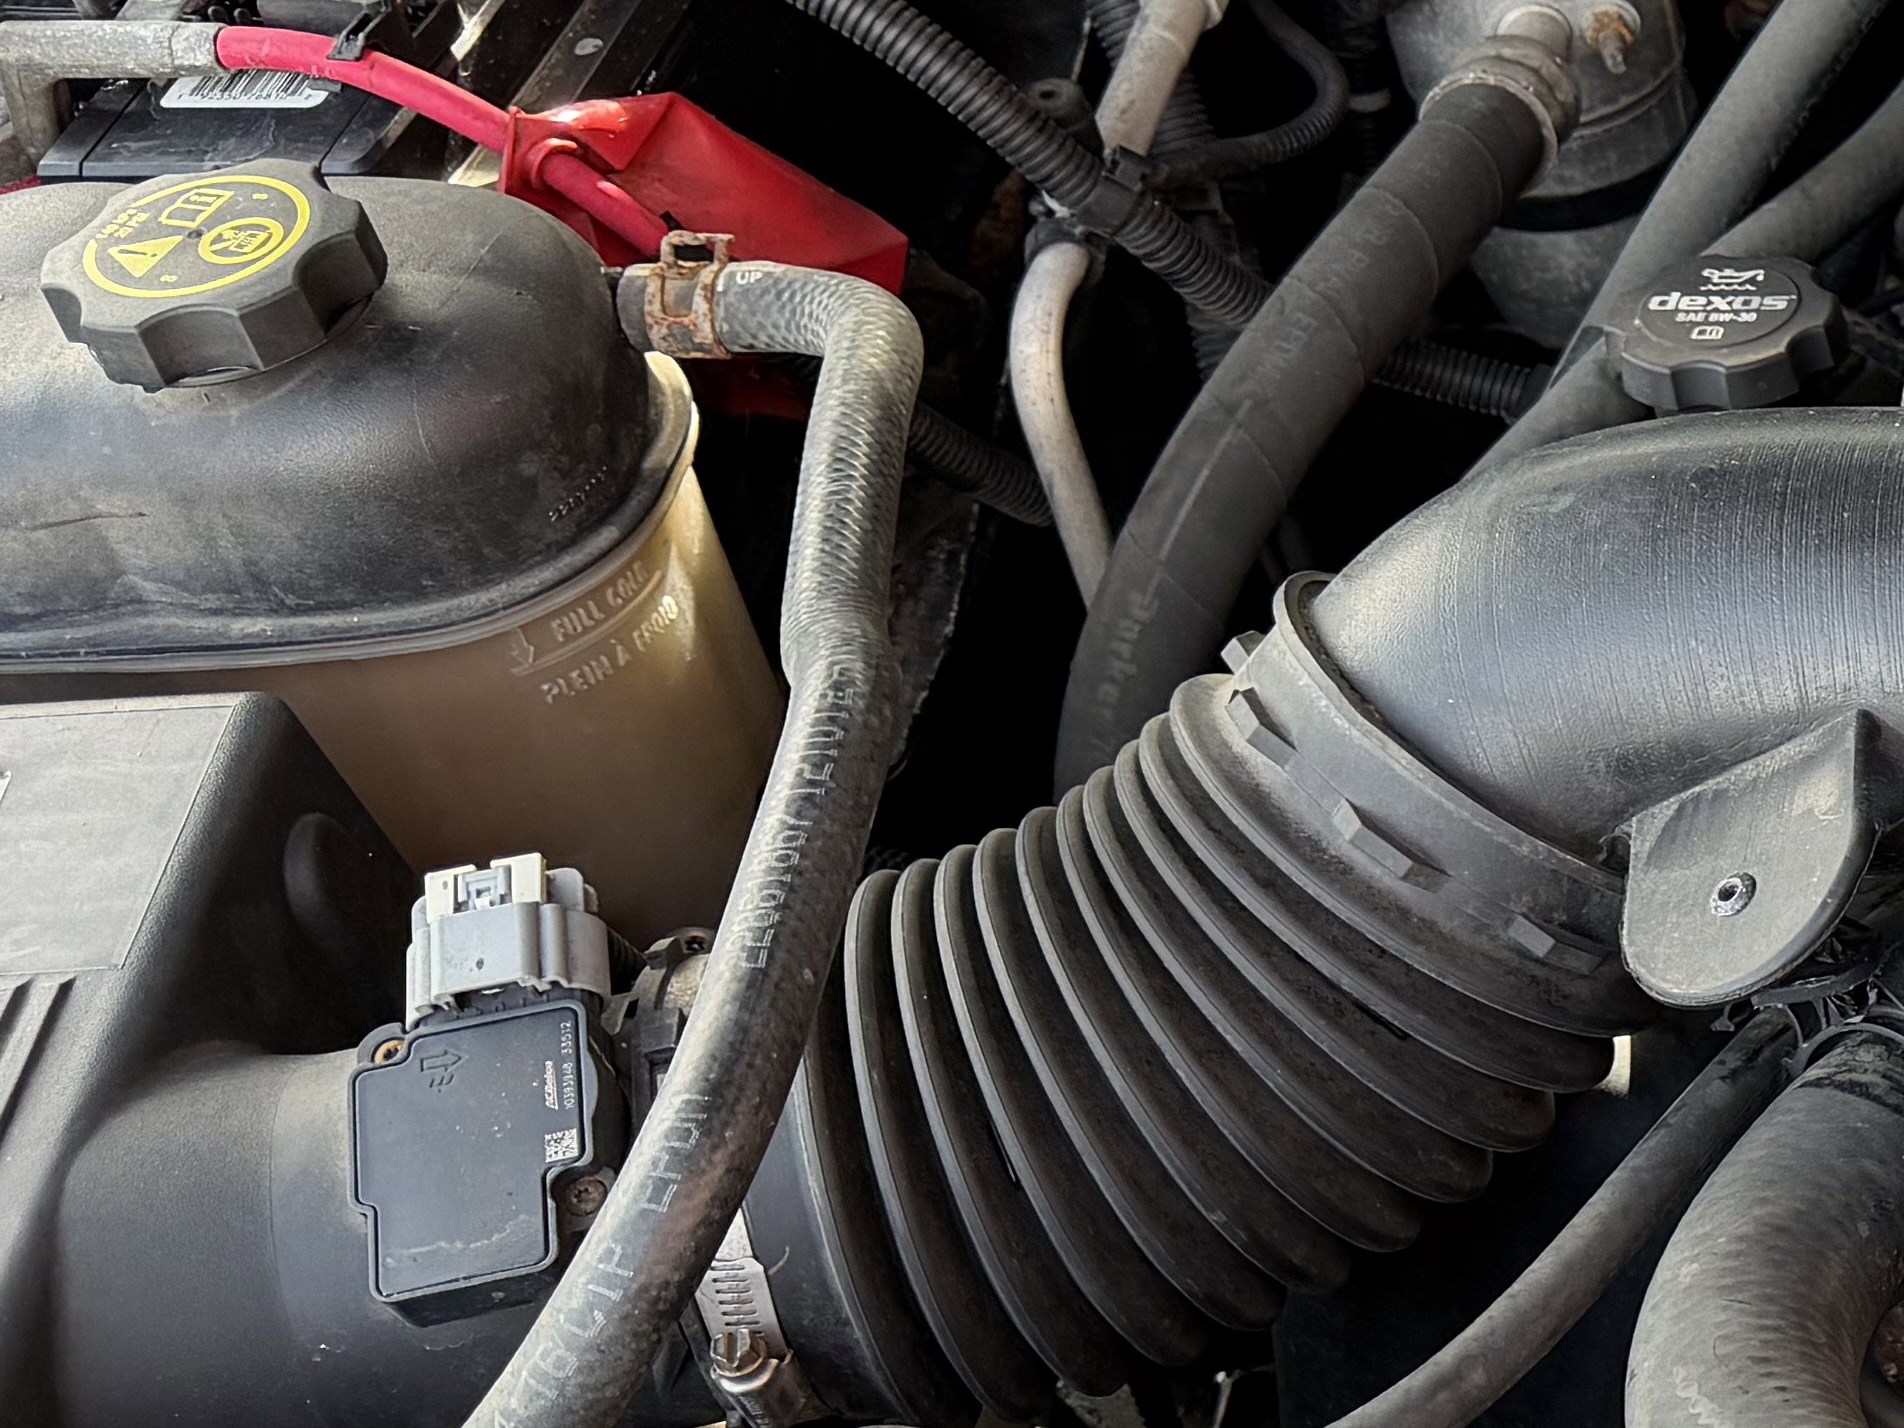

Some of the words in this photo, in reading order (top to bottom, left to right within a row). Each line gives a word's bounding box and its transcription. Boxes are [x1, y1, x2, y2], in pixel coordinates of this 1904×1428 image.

[735, 270, 763, 285] UP
[551, 600, 606, 643] FULL
[540, 655, 615, 704] PLEIN
[632, 594, 679, 652] FROID
